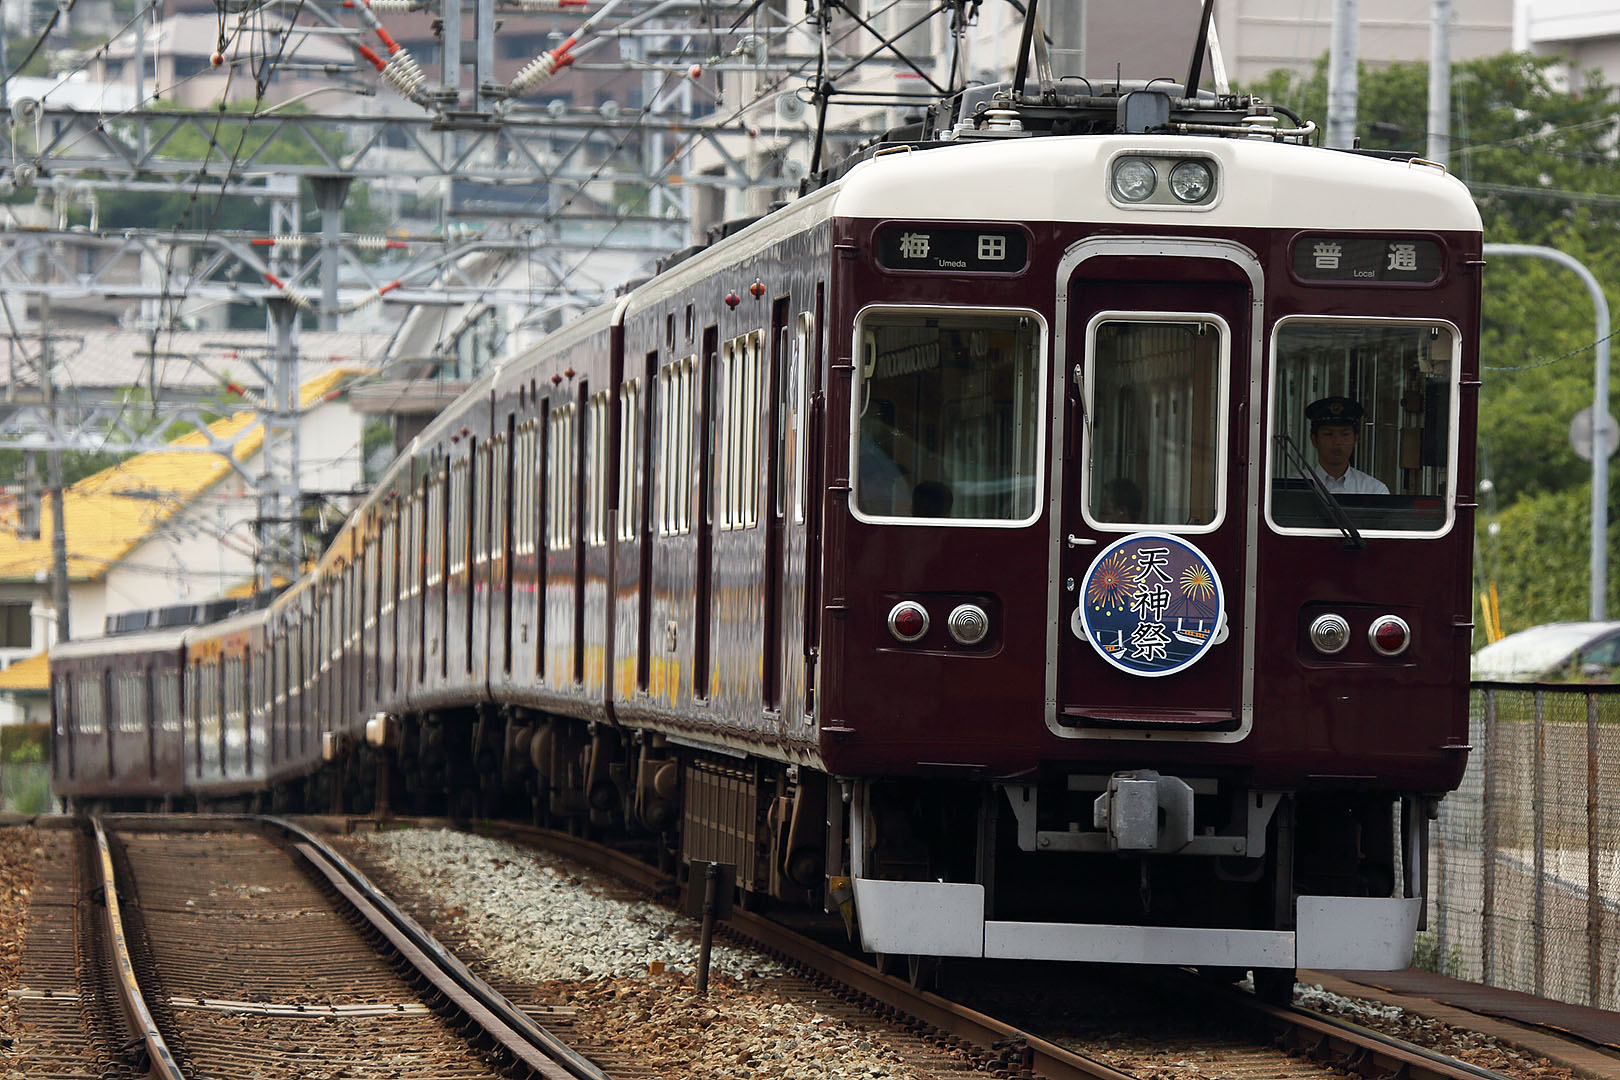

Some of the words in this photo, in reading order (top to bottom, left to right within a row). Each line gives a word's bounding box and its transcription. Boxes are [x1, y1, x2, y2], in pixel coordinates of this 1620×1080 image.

[900, 232, 1006, 261] 梅田
[1313, 242, 1417, 271] 普通
[938, 259, 967, 268] Umeda
[1353, 269, 1375, 278] Local
[1130, 547, 1174, 661] 天神祭
